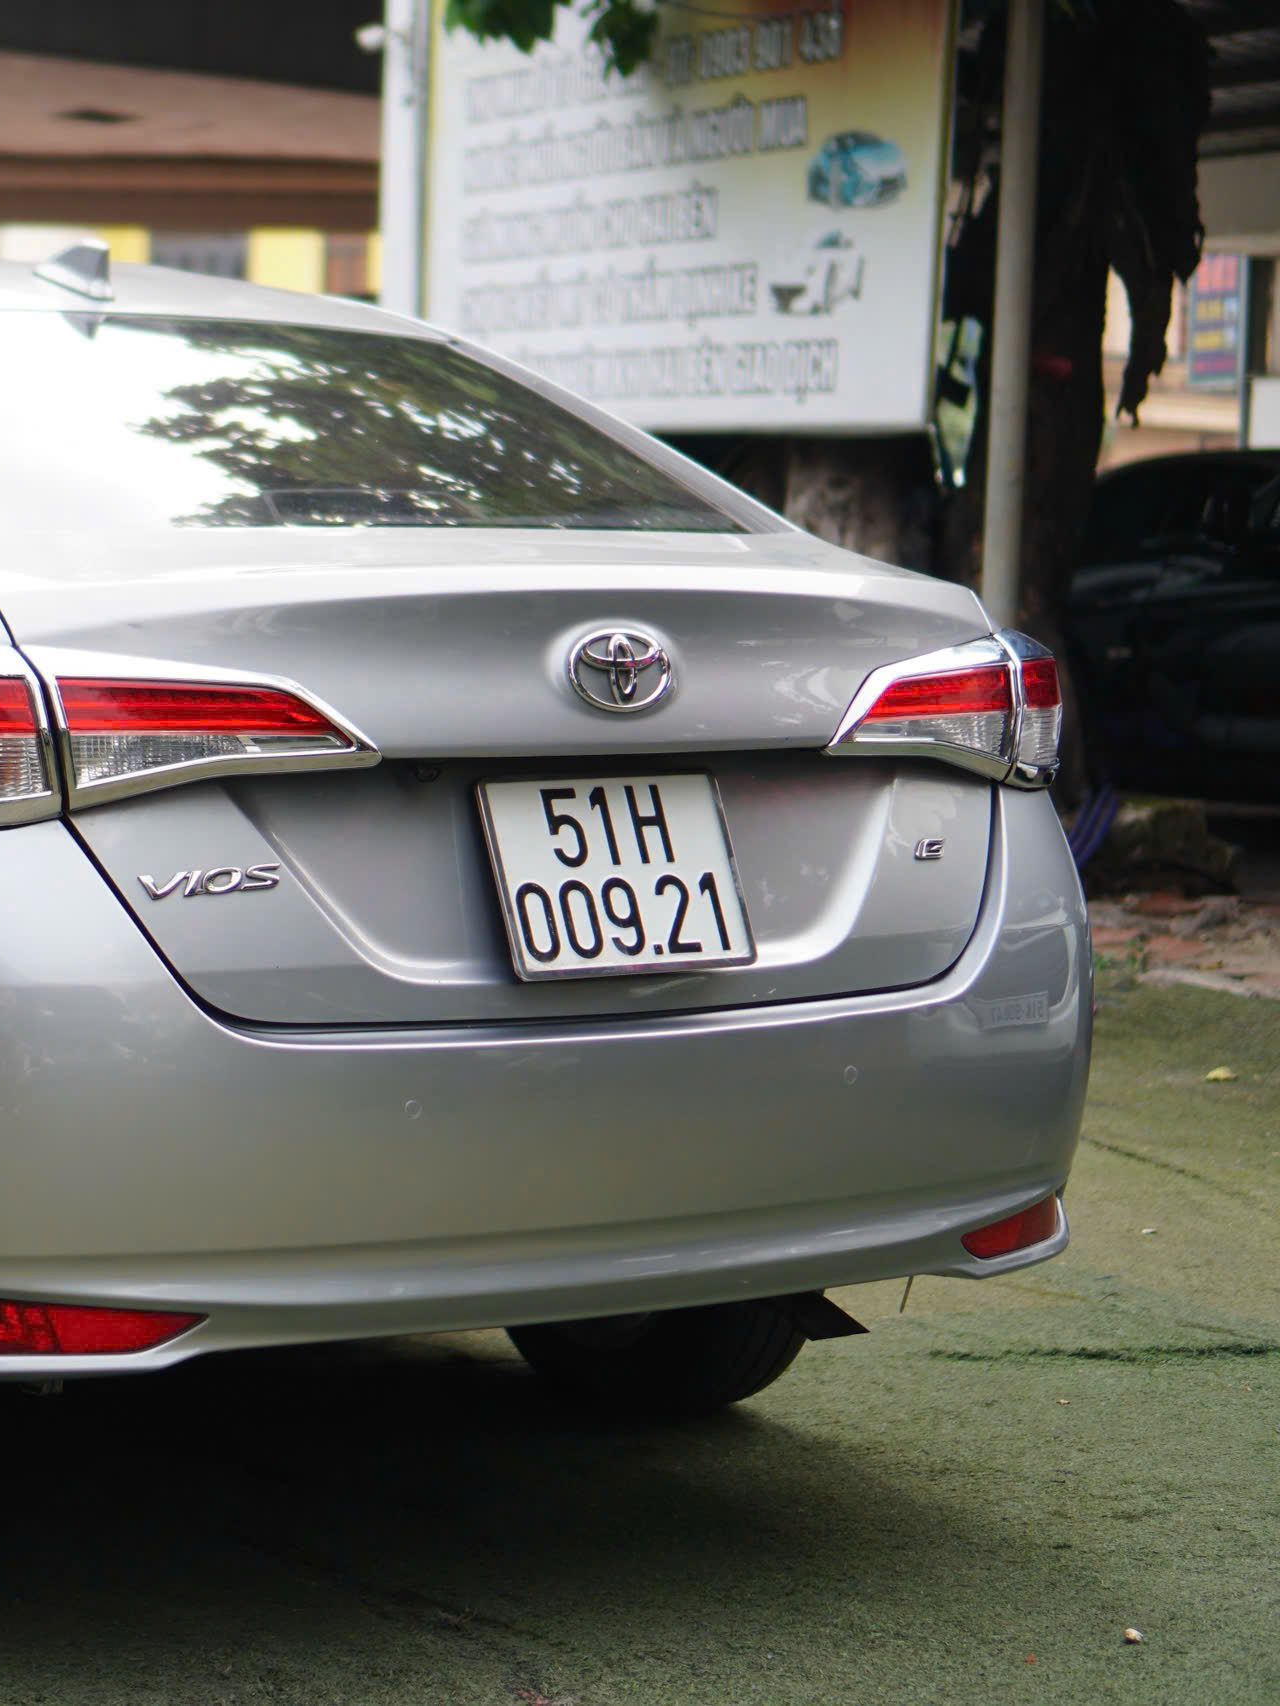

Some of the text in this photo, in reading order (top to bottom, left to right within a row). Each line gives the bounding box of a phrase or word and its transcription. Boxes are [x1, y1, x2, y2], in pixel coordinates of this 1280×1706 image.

[757, 92, 808, 154] MUA
[539, 784, 675, 868] 51H
[137, 862, 281, 901] VIOS
[515, 872, 732, 962] 009.21
